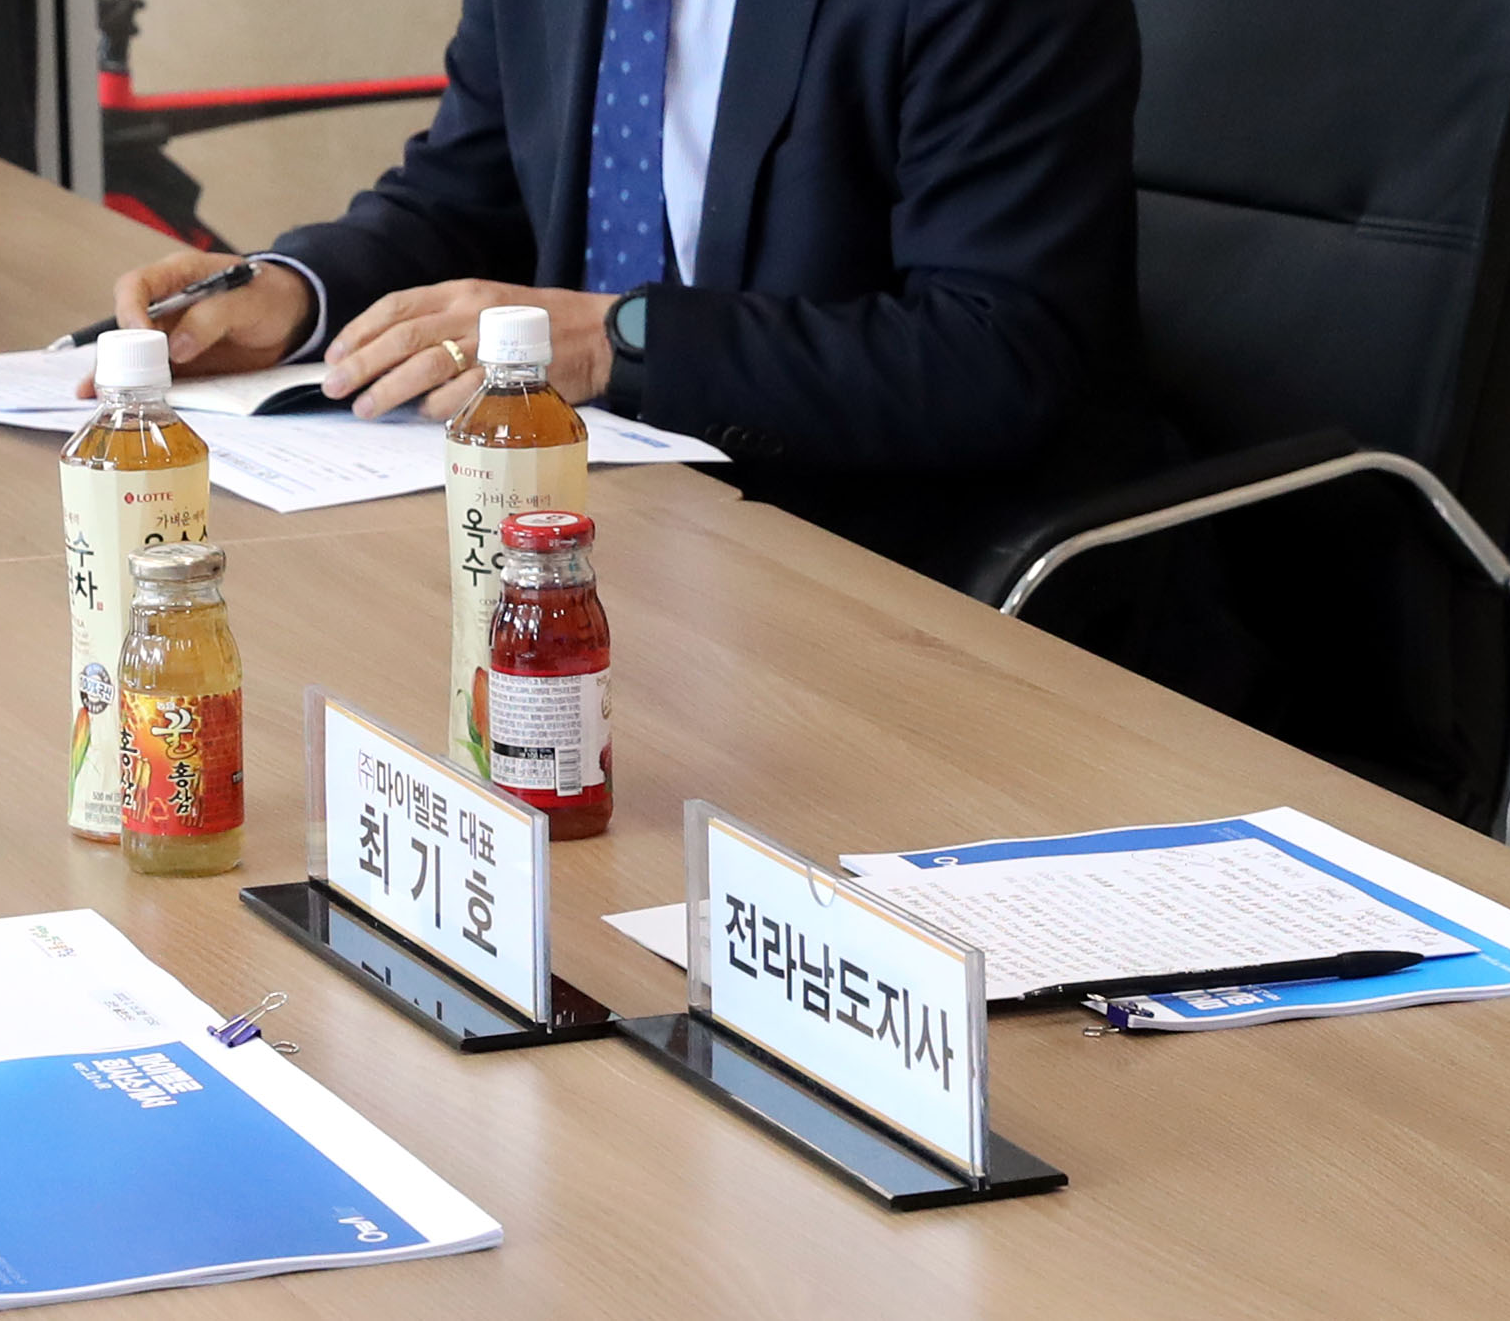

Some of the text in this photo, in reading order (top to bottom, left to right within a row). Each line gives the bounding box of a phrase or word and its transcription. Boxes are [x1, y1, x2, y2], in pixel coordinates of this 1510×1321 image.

[136, 492, 174, 503] LOTTE
[459, 467, 494, 480] LOTTE
[167, 761, 196, 815] 홍삼
[459, 809, 496, 867] 대표
[359, 803, 498, 958] 최 기 호
[725, 892, 955, 1093] 전라남도지사
[91, 1057, 178, 1110] 회사소개서
[129, 1052, 204, 1095] 마이벨로
